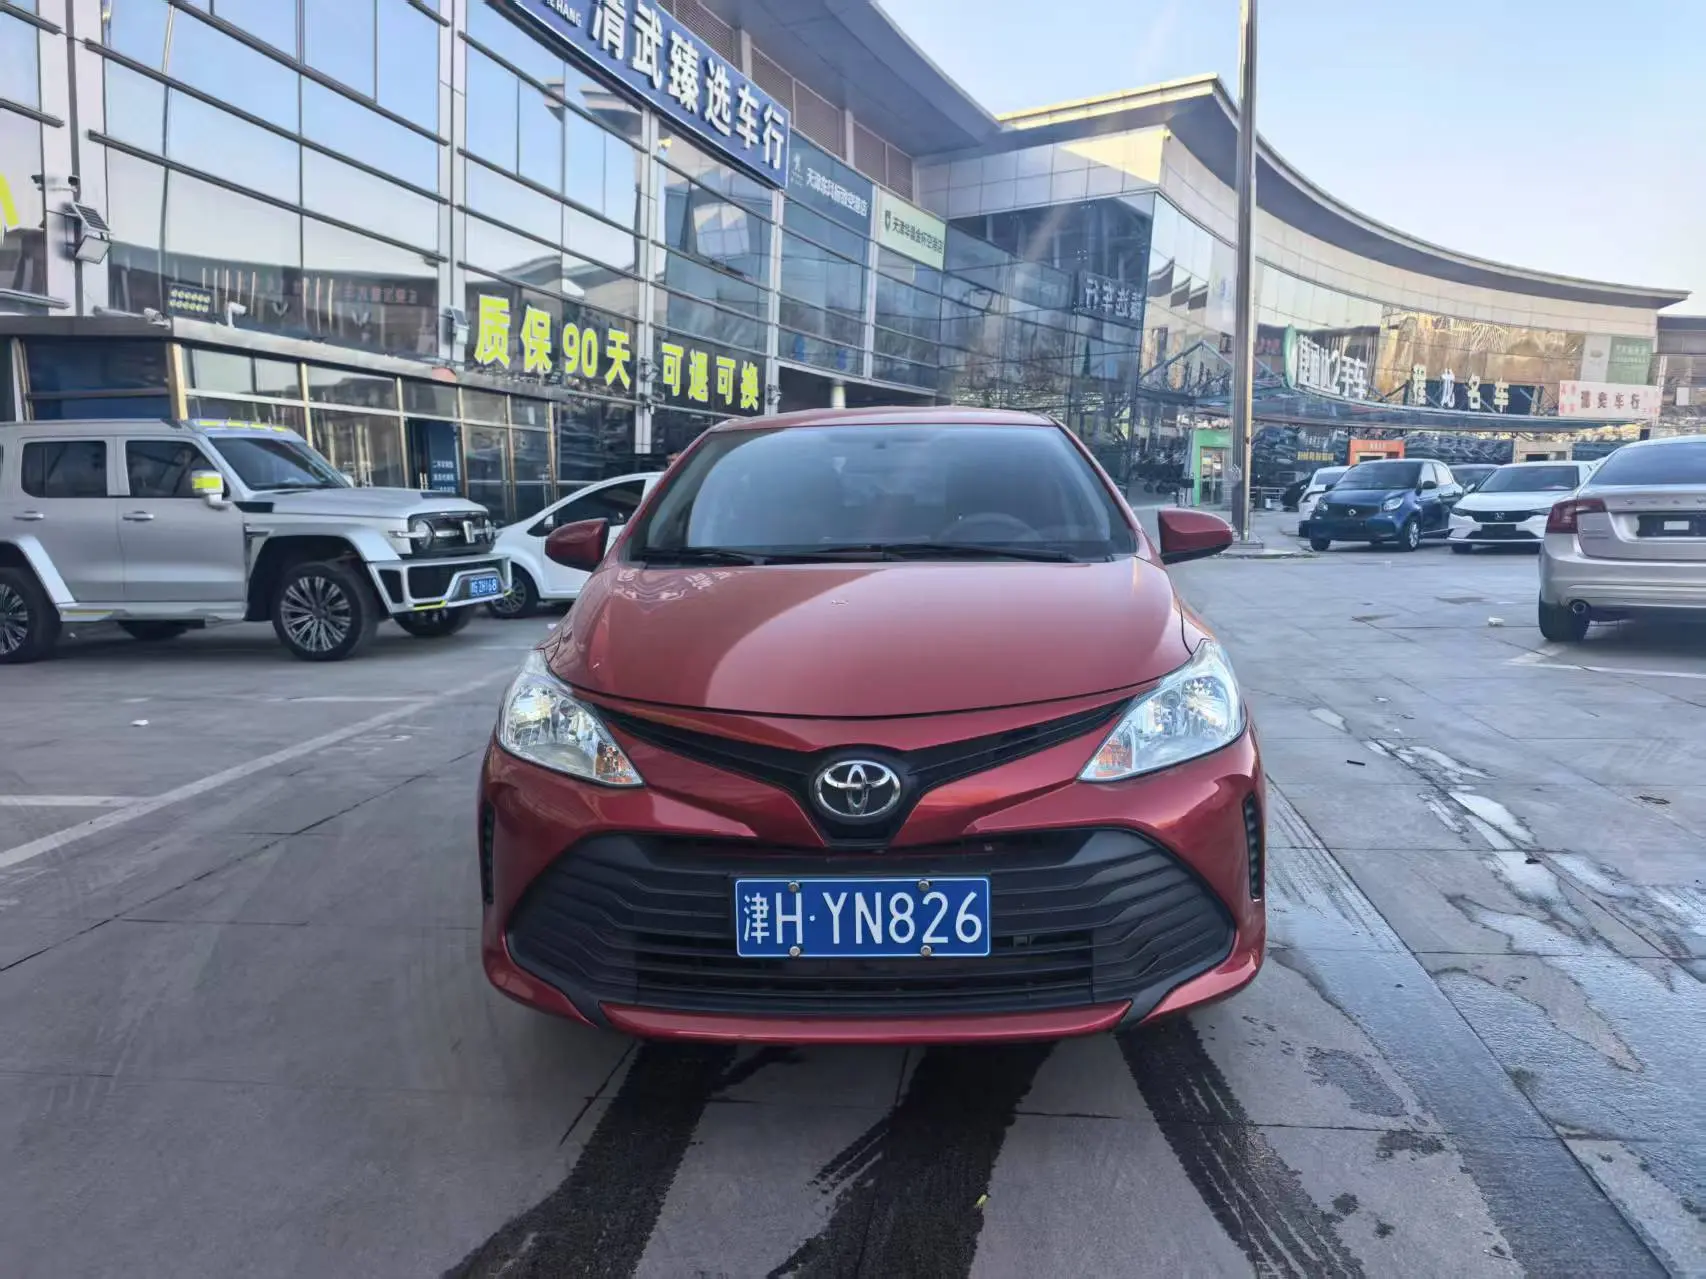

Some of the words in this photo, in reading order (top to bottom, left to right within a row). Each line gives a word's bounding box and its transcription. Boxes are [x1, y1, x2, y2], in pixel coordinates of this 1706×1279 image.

[474, 294, 631, 390] 质保90天
[661, 342, 759, 411] 可退可换
